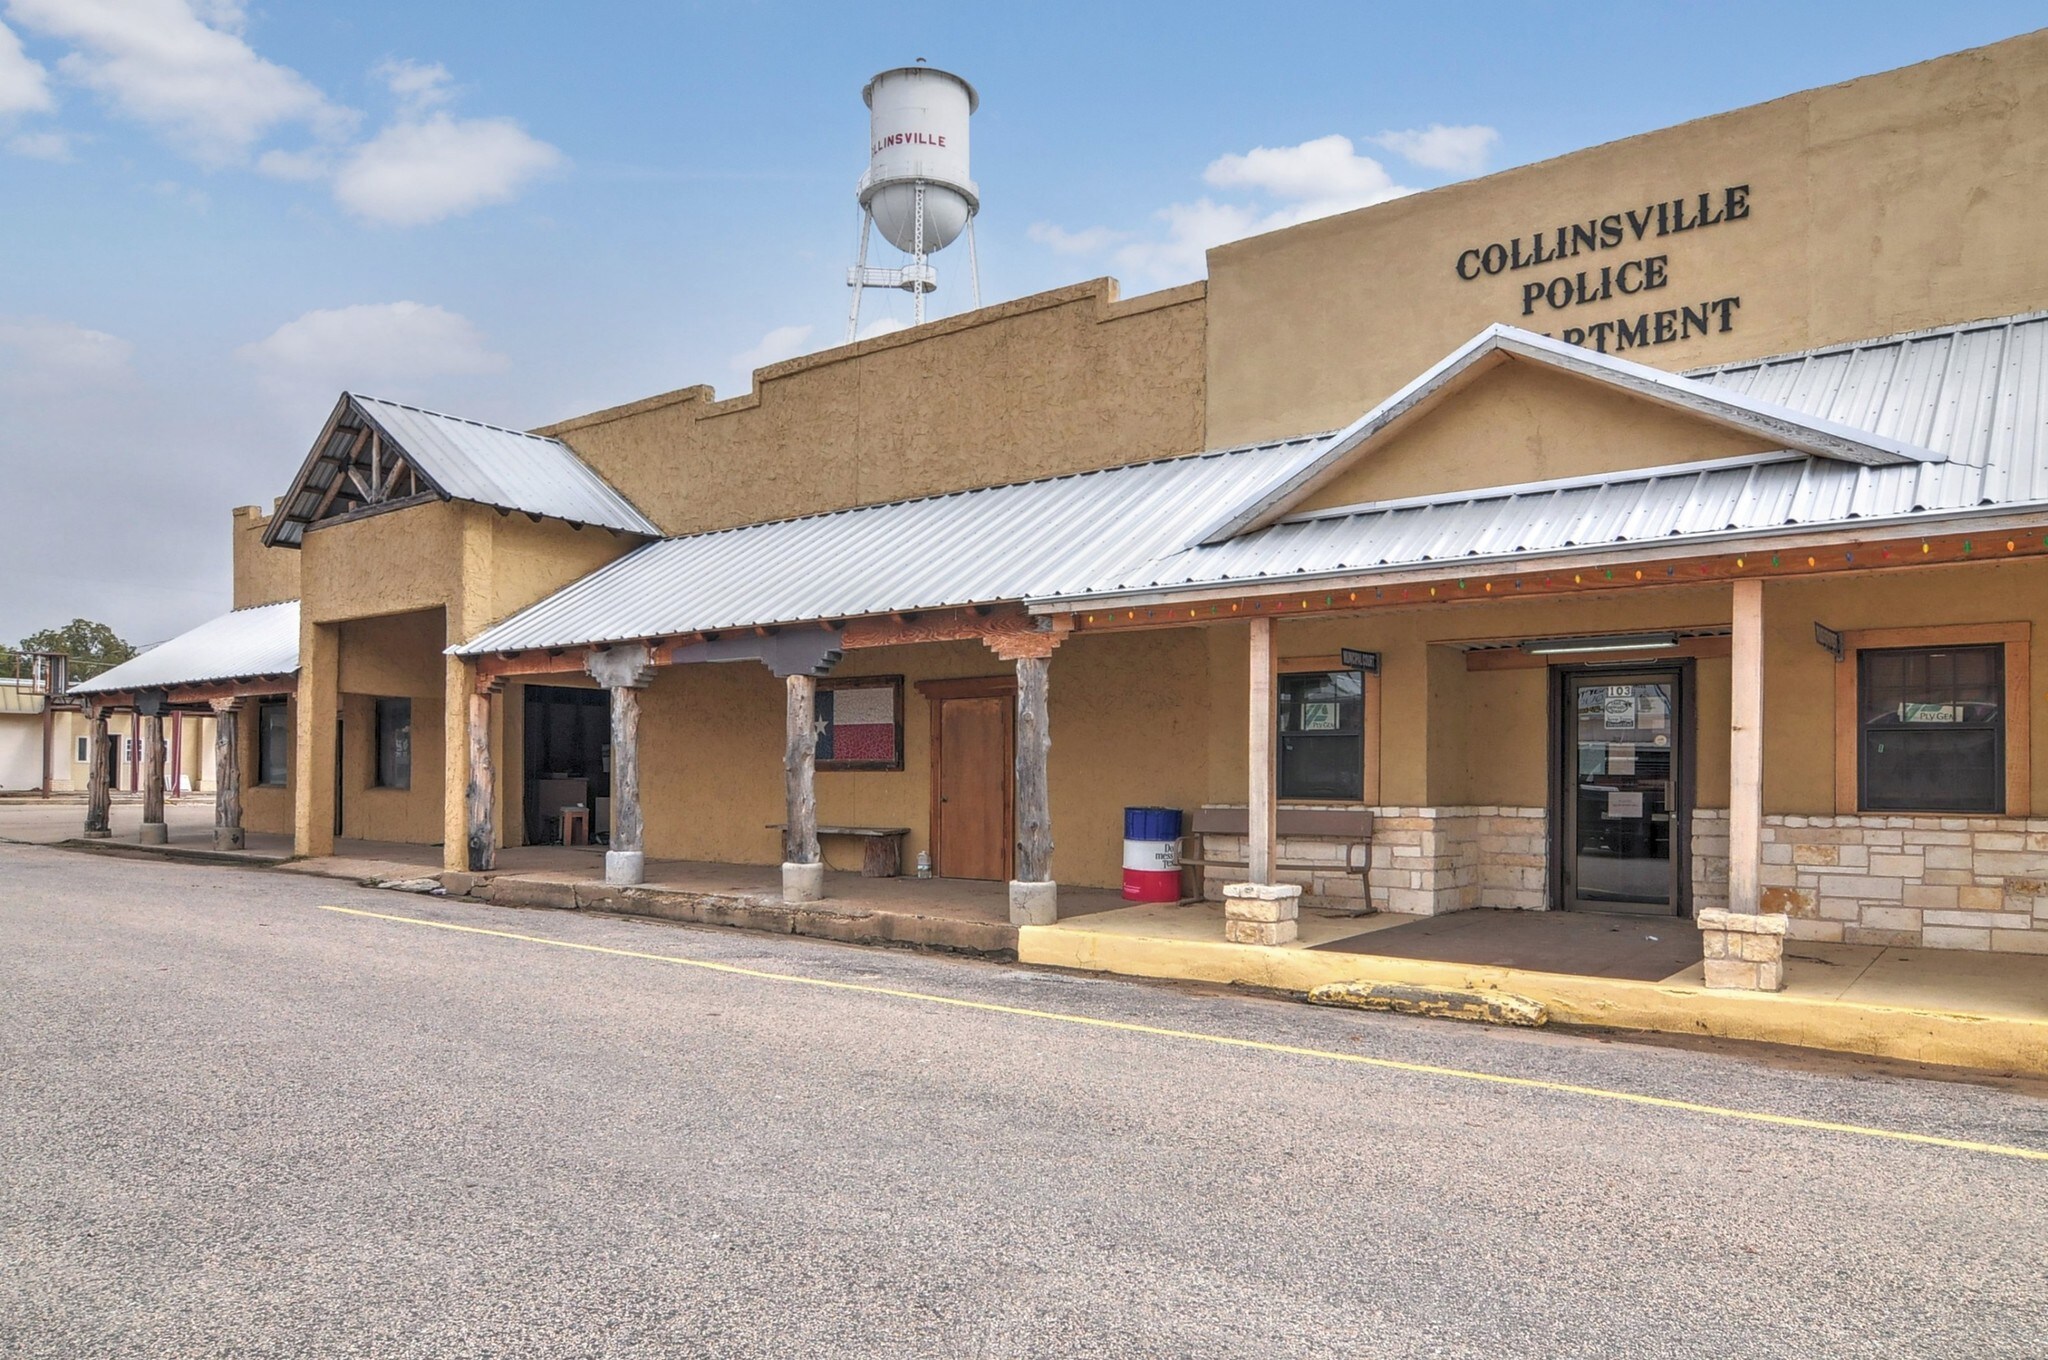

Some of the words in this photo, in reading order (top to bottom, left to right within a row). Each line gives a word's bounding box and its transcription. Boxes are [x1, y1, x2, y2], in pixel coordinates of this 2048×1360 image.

[872, 133, 946, 154] LLINSVILLE
[1456, 184, 1750, 280] COLLINSVILLE
[1522, 254, 1668, 315] POLICE
[1543, 296, 1740, 354] RTMENT
[1610, 686, 1631, 696] 103
